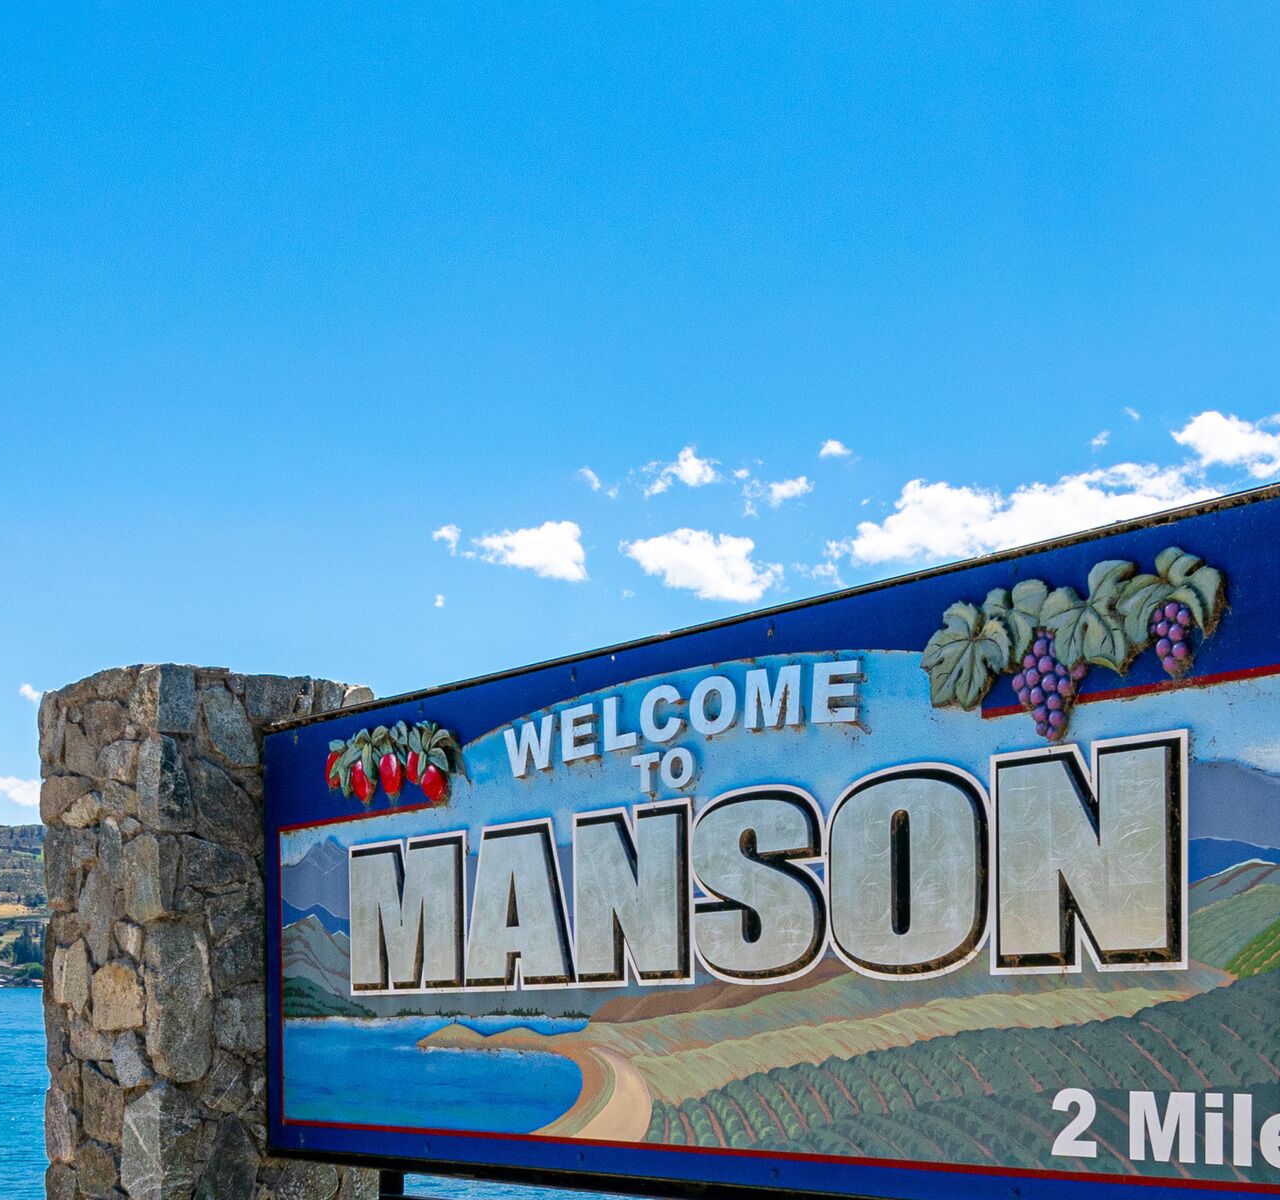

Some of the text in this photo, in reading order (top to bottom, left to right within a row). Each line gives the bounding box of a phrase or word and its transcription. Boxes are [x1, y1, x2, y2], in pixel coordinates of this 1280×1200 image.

[503, 659, 861, 779] WELCOME
[631, 746, 696, 793] TO
[348, 727, 1189, 996] MANSON
[1051, 1087, 1098, 1159] 2
